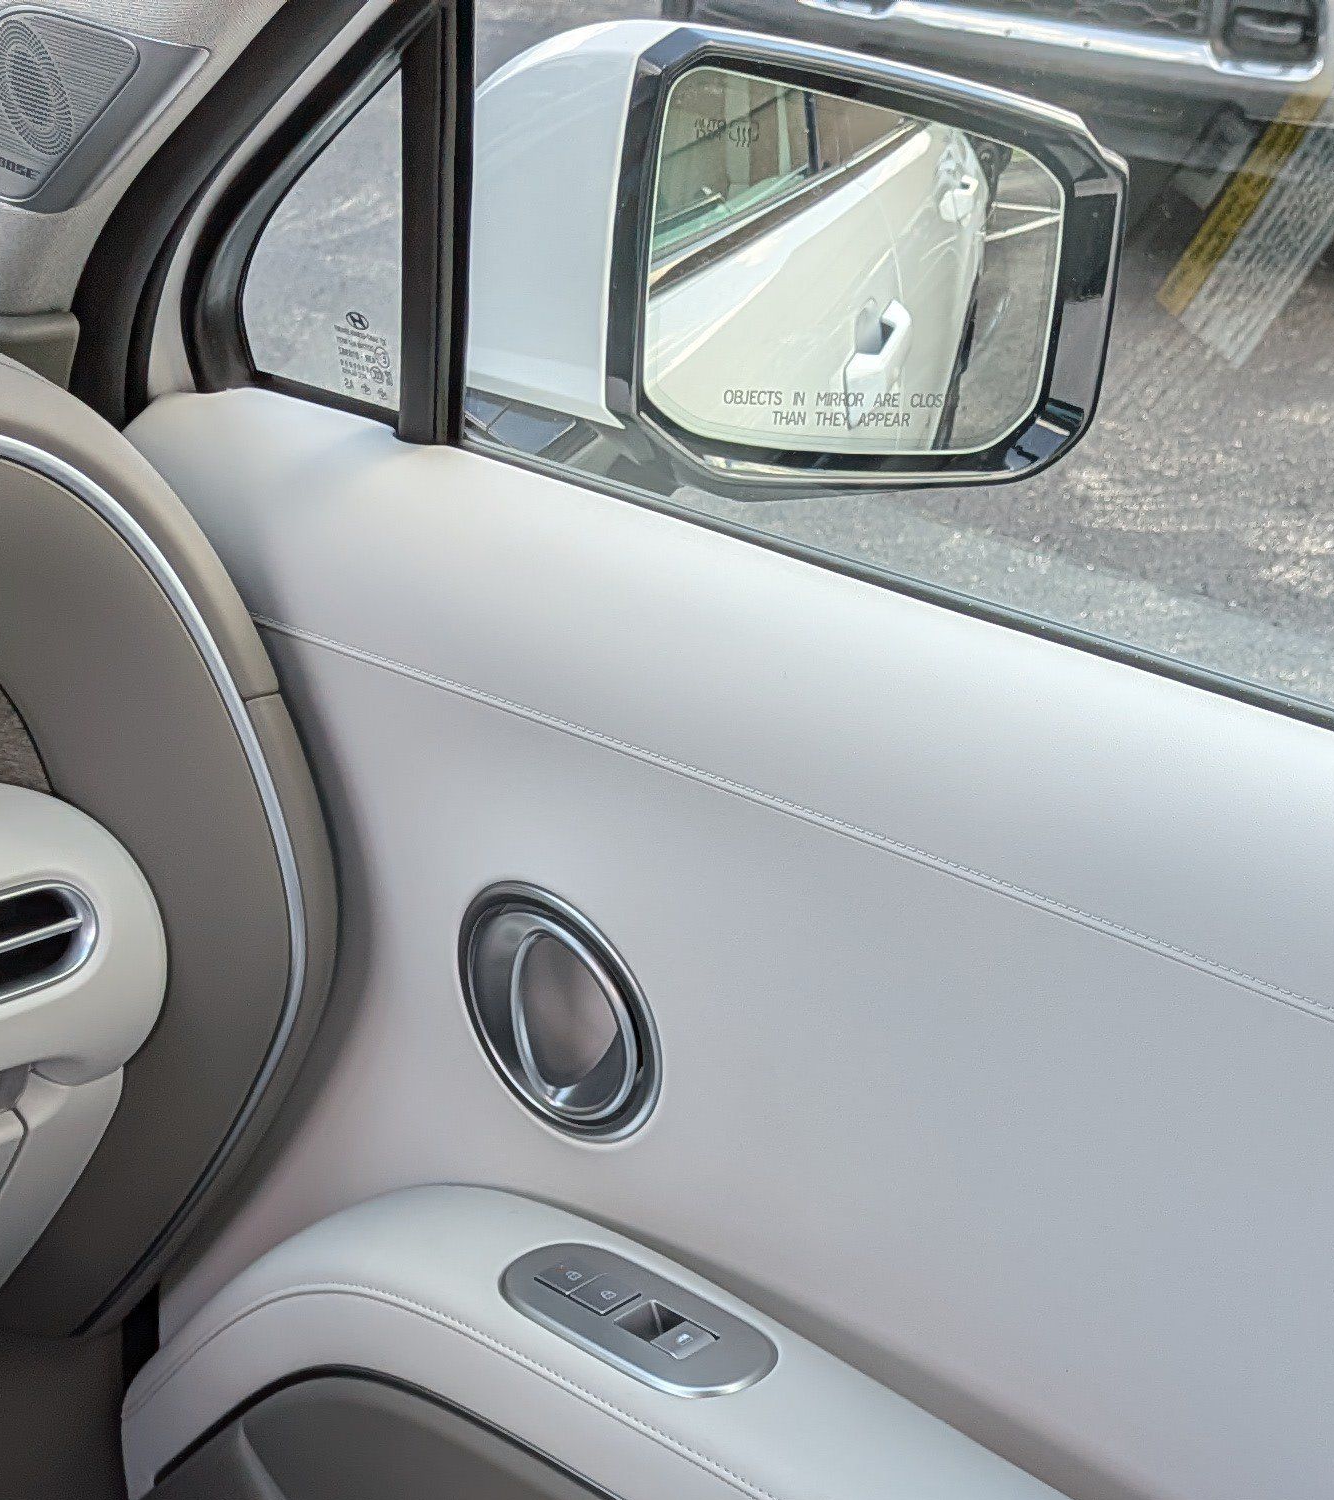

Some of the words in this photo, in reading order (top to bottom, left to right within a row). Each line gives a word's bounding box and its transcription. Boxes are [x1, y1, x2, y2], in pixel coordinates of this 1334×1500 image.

[723, 390, 783, 406] OBJECTS
[793, 392, 805, 406] IN
[816, 392, 864, 407] MIRROR
[873, 393, 900, 408] ARE
[772, 411, 806, 426] THAN
[815, 411, 849, 427] THEY
[858, 413, 910, 427] APPEAR
